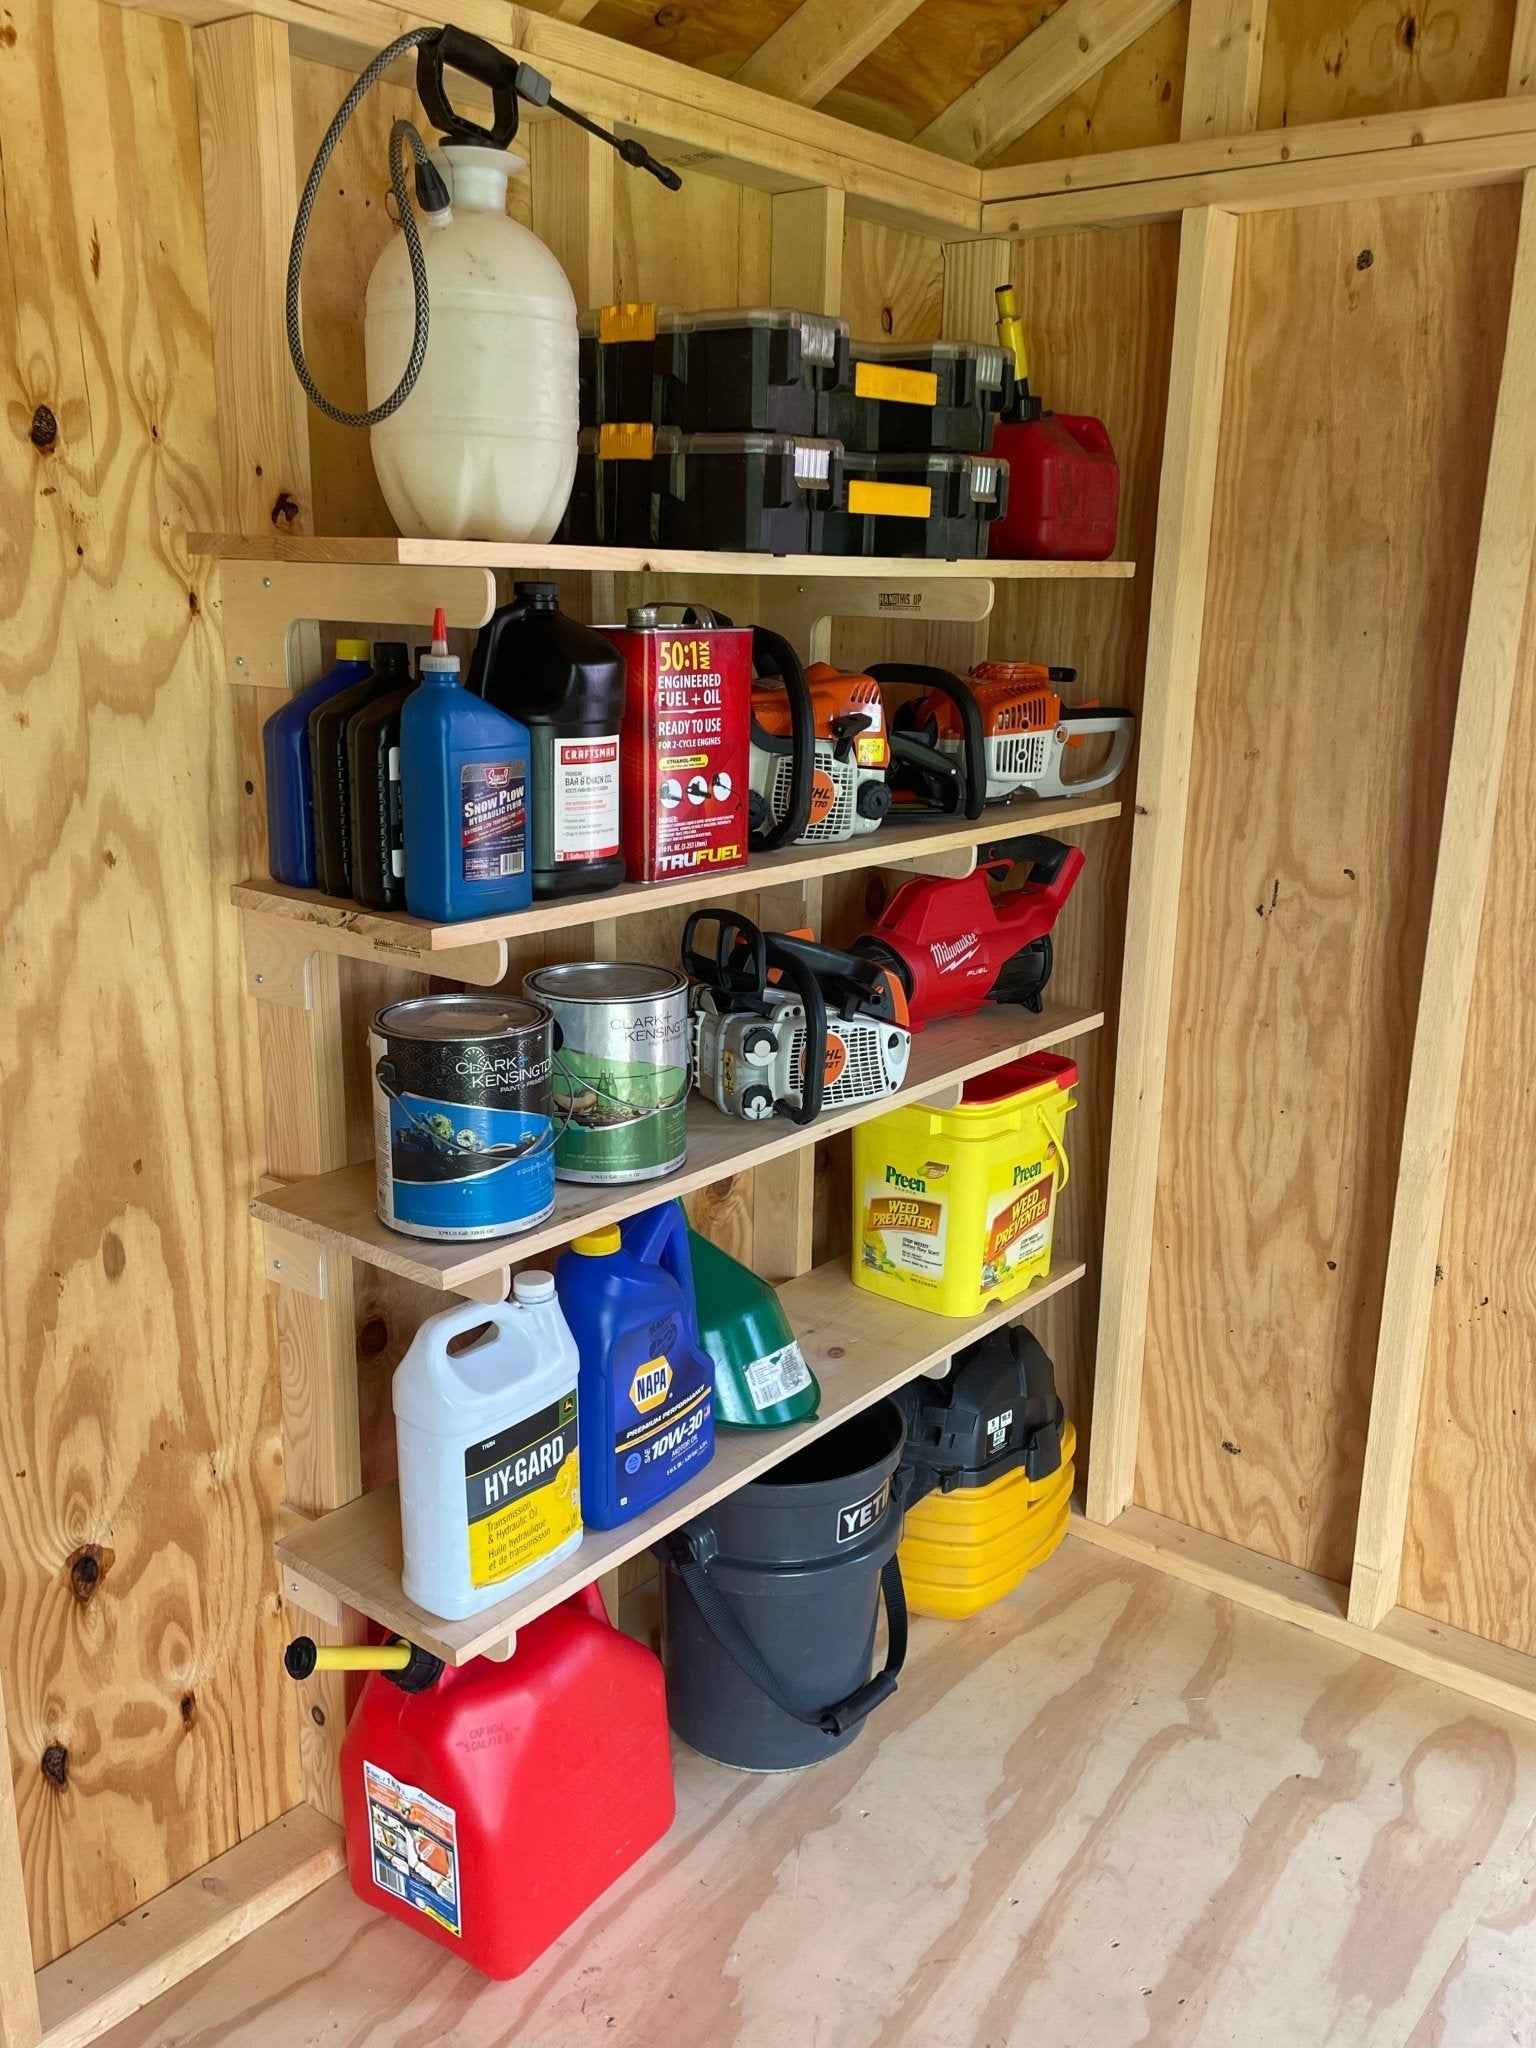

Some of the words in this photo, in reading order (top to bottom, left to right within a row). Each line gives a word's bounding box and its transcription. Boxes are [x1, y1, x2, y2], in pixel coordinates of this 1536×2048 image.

[913, 593, 922, 605] UP
[660, 640, 698, 672] 50:1
[699, 640, 711, 670] MIX
[658, 673, 721, 690] ENGINEERED
[658, 691, 688, 708] FUEL
[704, 689, 721, 704] OIL
[658, 720, 690, 736] READY
[692, 719, 703, 734] TO
[705, 717, 721, 732] USE
[565, 747, 615, 760] CRAFTSMAN
[658, 741, 671, 750] FOR
[672, 739, 696, 749] 2-CYCLE
[697, 737, 721, 747] ENGINES
[565, 777, 579, 787] BAR
[586, 775, 604, 785] CHAIN
[469, 807, 505, 826] HYDRAULIC
[506, 799, 522, 813] FLUID
[659, 844, 741, 871] TRUFUEL
[930, 932, 978, 969] Milwaukee
[966, 967, 988, 977] FUEL
[500, 1084, 520, 1093] PAINT
[885, 1165, 926, 1193] Preen
[1013, 1161, 1042, 1187] Preen
[888, 1200, 920, 1215] WEED
[1012, 1189, 1040, 1221] WEED
[873, 1212, 933, 1230] PREVENTER
[995, 1198, 1048, 1253] PREVENTER
[636, 1367, 667, 1402] NAPA
[626, 1415, 662, 1439] PREMIUM
[662, 1383, 705, 1420] PERFORMANCE
[651, 1408, 703, 1460] 10W-30
[672, 1439, 690, 1458] MOTOR
[485, 1436, 564, 1506] HY-GARD
[487, 1500, 532, 1532] Transmission
[843, 1488, 887, 1533] YETI
[488, 1534, 494, 1545] &
[496, 1515, 528, 1541] Hydraulic
[529, 1506, 538, 1520] Oil
[488, 1544, 507, 1560] Huile
[508, 1519, 547, 1551] hydraulique
[488, 1560, 497, 1571] et
[498, 1554, 508, 1566] de
[509, 1527, 551, 1560] transmission
